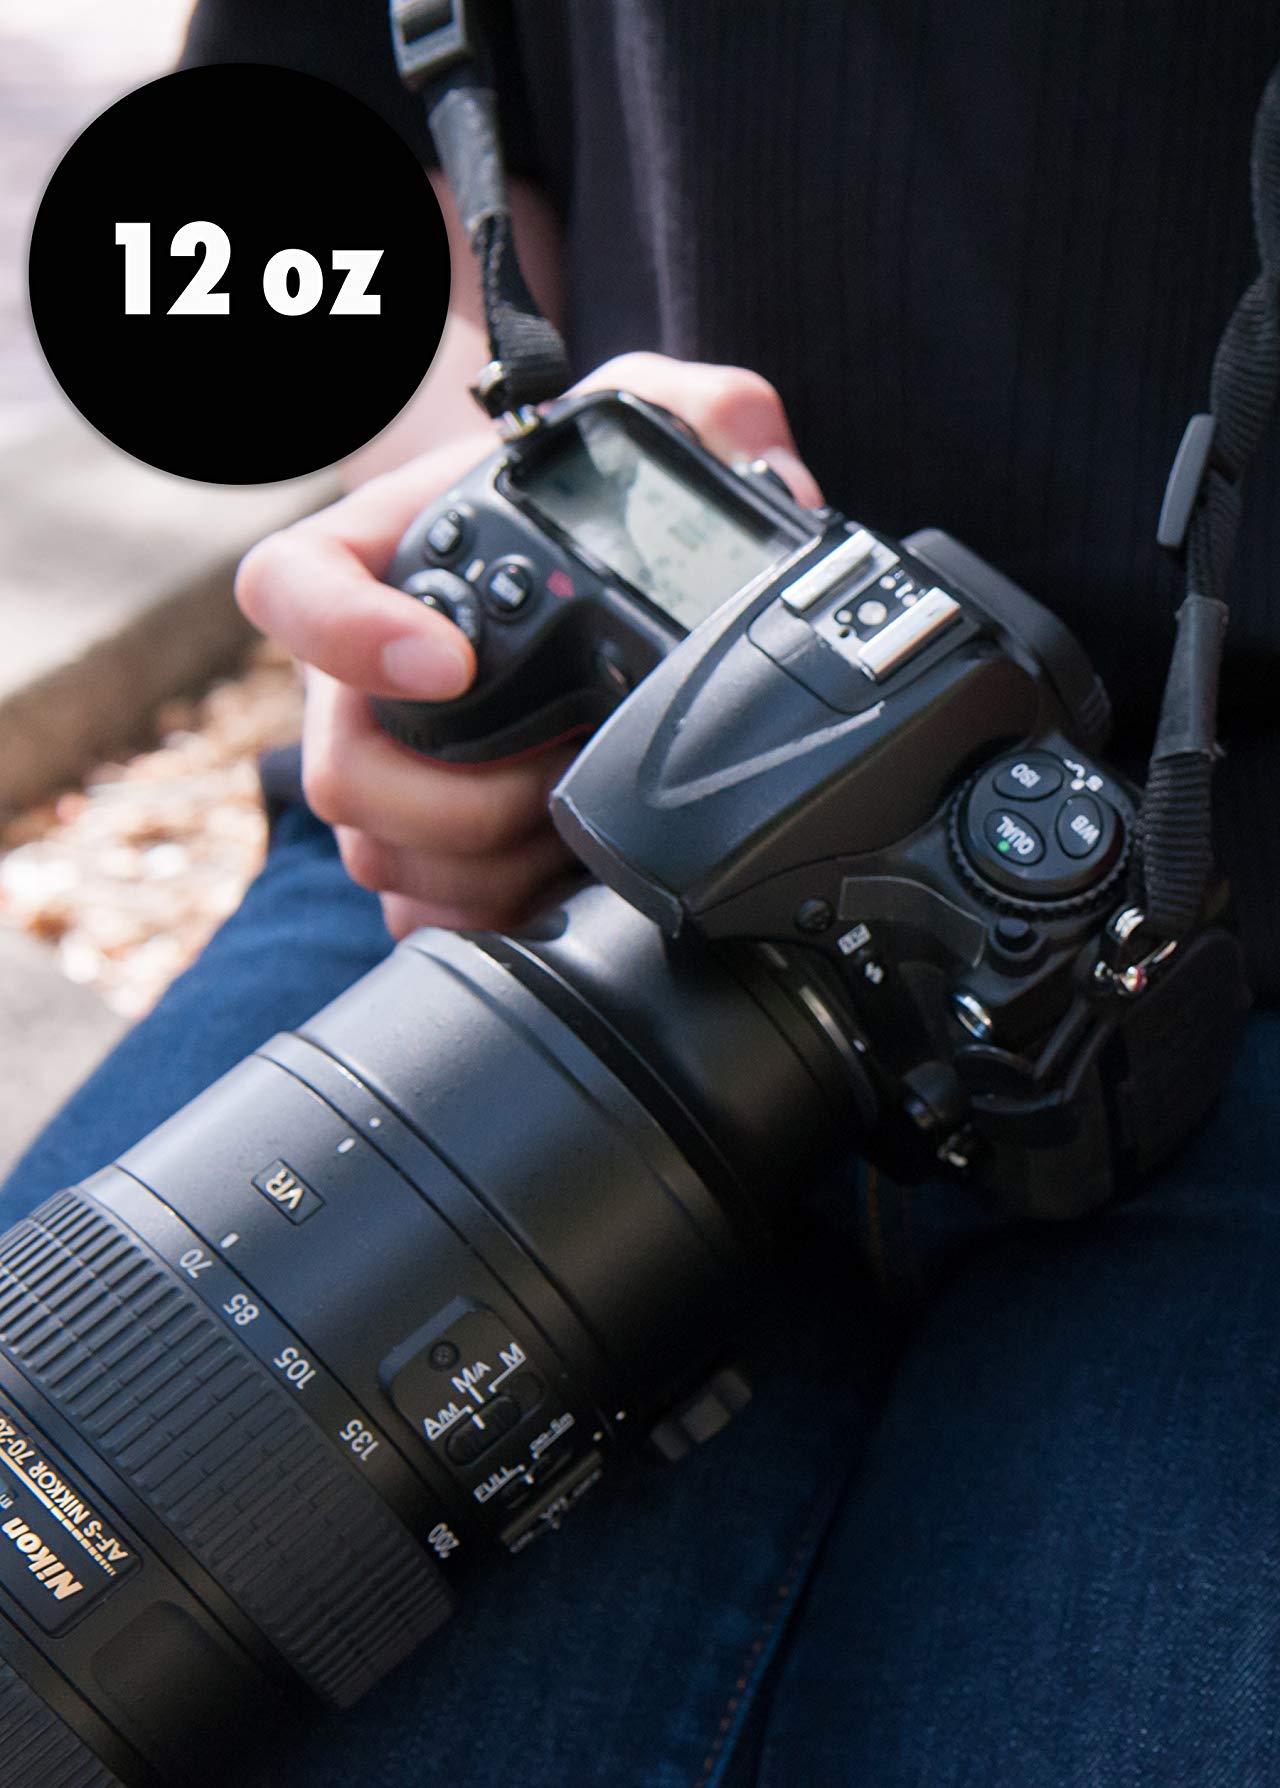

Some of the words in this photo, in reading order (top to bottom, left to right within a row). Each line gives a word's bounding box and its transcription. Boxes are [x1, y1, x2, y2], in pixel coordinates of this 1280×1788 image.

[1010, 763, 1041, 789] ISO
[996, 815, 1035, 855] QUAL
[1070, 815, 1100, 845] WB
[265, 1168, 304, 1210] VR
[179, 1249, 213, 1279] 70
[223, 1293, 260, 1325] 85
[273, 1347, 317, 1390] 105
[499, 1342, 526, 1368] M
[451, 1362, 491, 1393] M/A
[423, 1402, 461, 1438] A/M
[339, 1419, 380, 1461] 135
[28, 1460, 90, 1525] NIKKOR
[473, 1467, 516, 1502] FULL
[1, 1517, 84, 1600] Nikon
[84, 1520, 128, 1562] AF-S
